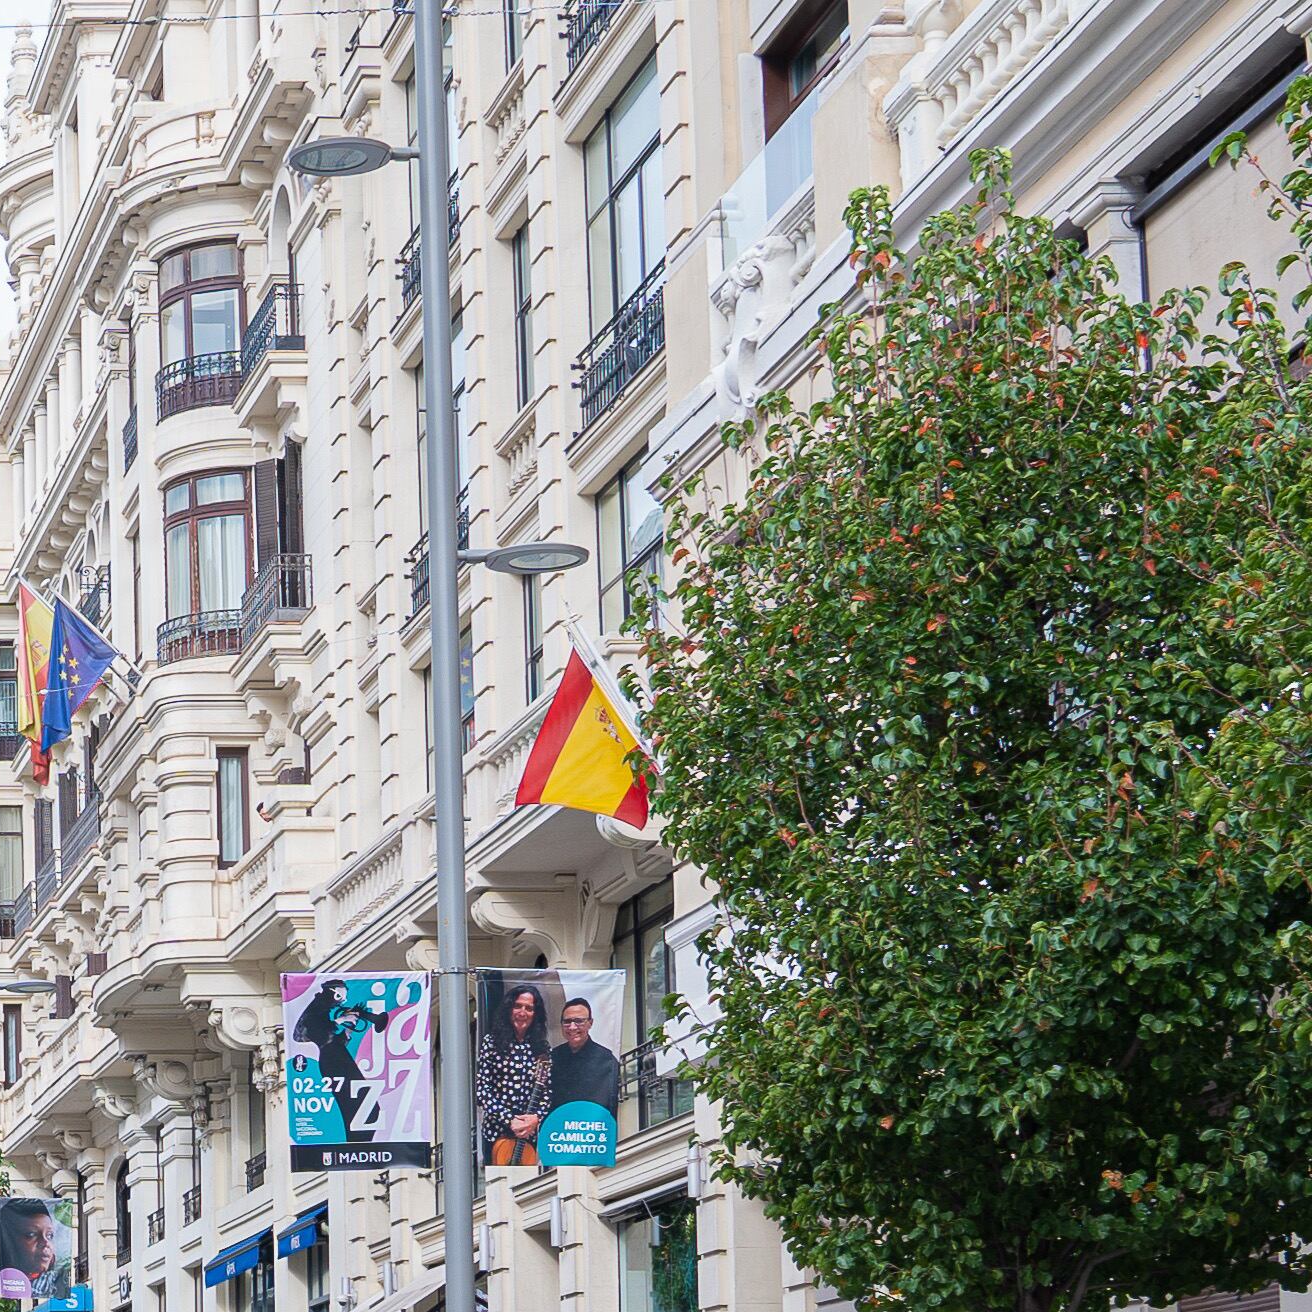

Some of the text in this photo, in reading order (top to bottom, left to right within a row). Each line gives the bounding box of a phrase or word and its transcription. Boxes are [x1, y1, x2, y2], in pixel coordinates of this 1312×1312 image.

[292, 1077, 345, 1094] 02-27
[294, 1097, 335, 1113] NOV
[564, 1121, 608, 1131] MICHEL
[550, 1133, 608, 1143] CAMILO &
[548, 1144, 607, 1154] TOMATITO
[339, 1151, 393, 1163] MADRID
